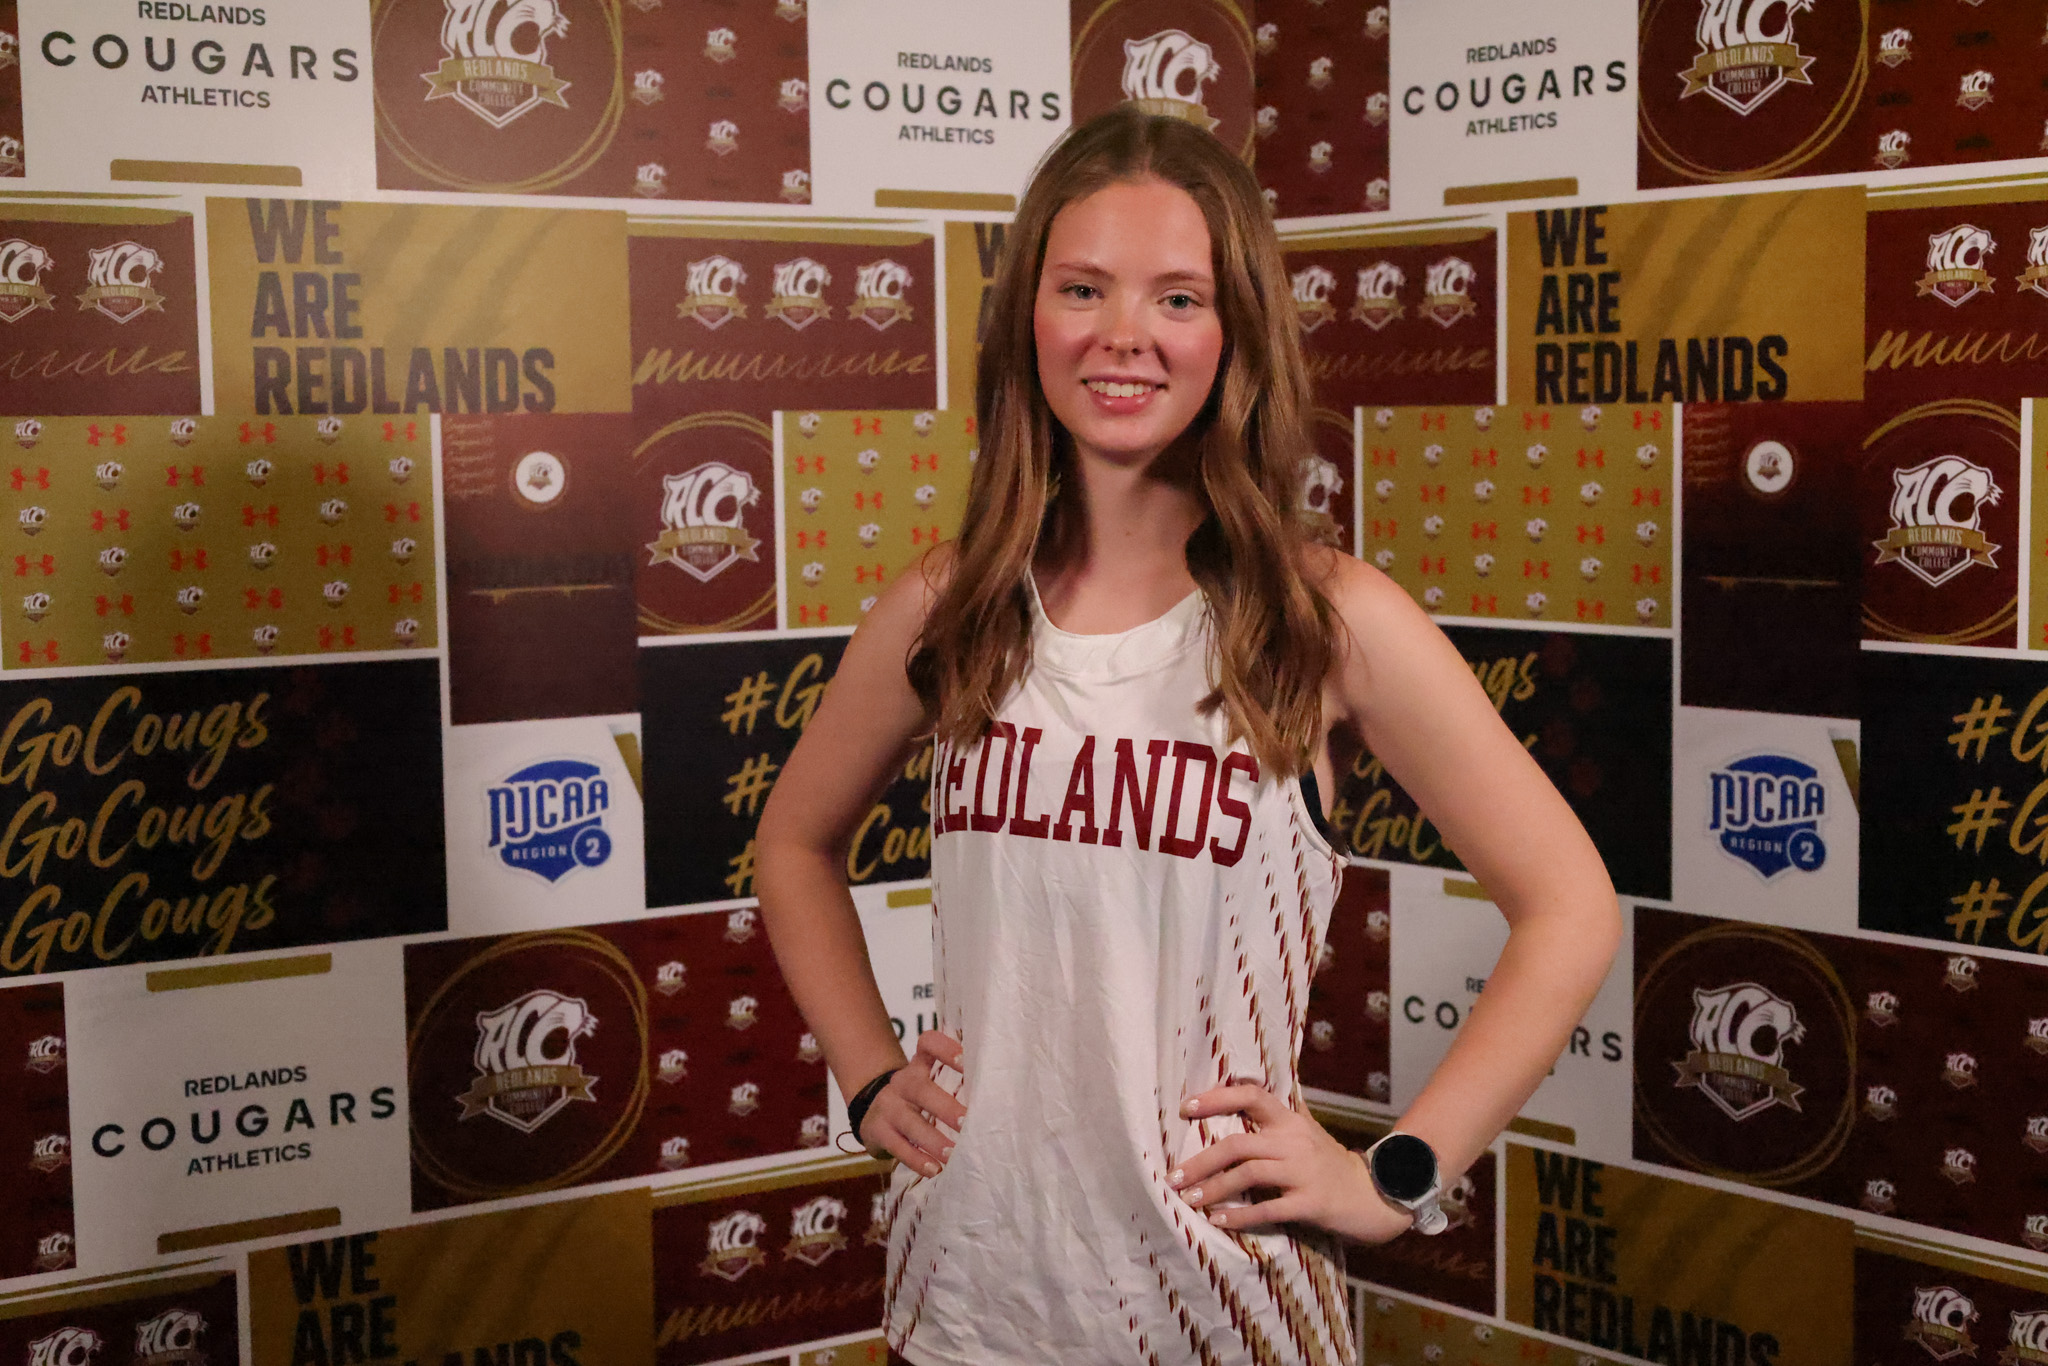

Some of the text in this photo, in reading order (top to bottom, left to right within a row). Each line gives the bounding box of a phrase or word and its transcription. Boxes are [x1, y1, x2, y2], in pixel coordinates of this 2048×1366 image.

[138, 1, 266, 26] REDLANDS
[41, 31, 360, 82] COUGARS
[463, 59, 529, 80] REDLANDS
[897, 52, 993, 74] REDLANDS
[1466, 37, 1557, 64] REDLANDS
[1714, 45, 1775, 69] REDLANDS
[141, 85, 271, 109] ATHLETICS
[825, 78, 1061, 121] COUGARS
[1403, 61, 1627, 115] COUGARS
[899, 125, 995, 145] ATHLETICS
[1466, 112, 1558, 136] ATHLETICS
[248, 198, 344, 265] WE
[1536, 206, 1607, 267] WE
[250, 270, 363, 339] ARE
[1535, 272, 1621, 336] ARE
[253, 346, 556, 416] REDLANDS
[1535, 335, 1788, 405] REDLANDS
[1907, 527, 1963, 545] REDLANDS
[0, 686, 270, 791] GoCougs
[487, 777, 609, 847] NJCAA
[1709, 772, 1825, 831] NJCAA
[0, 779, 273, 885] GoCougs
[512, 837, 601, 860] REGION 2
[1730, 835, 1815, 863] REGION 2
[0, 873, 278, 975] GoCougs
[184, 1066, 308, 1098] REDLANDS
[92, 1087, 397, 1158] COUGARS
[187, 1142, 312, 1176] ATHLETICS
[1534, 1148, 1604, 1217] WE
[287, 1231, 380, 1303] WE
[1533, 1211, 1618, 1286] ARE
[291, 1296, 398, 1366] ARE
[1533, 1274, 1780, 1366] REDLANDS
